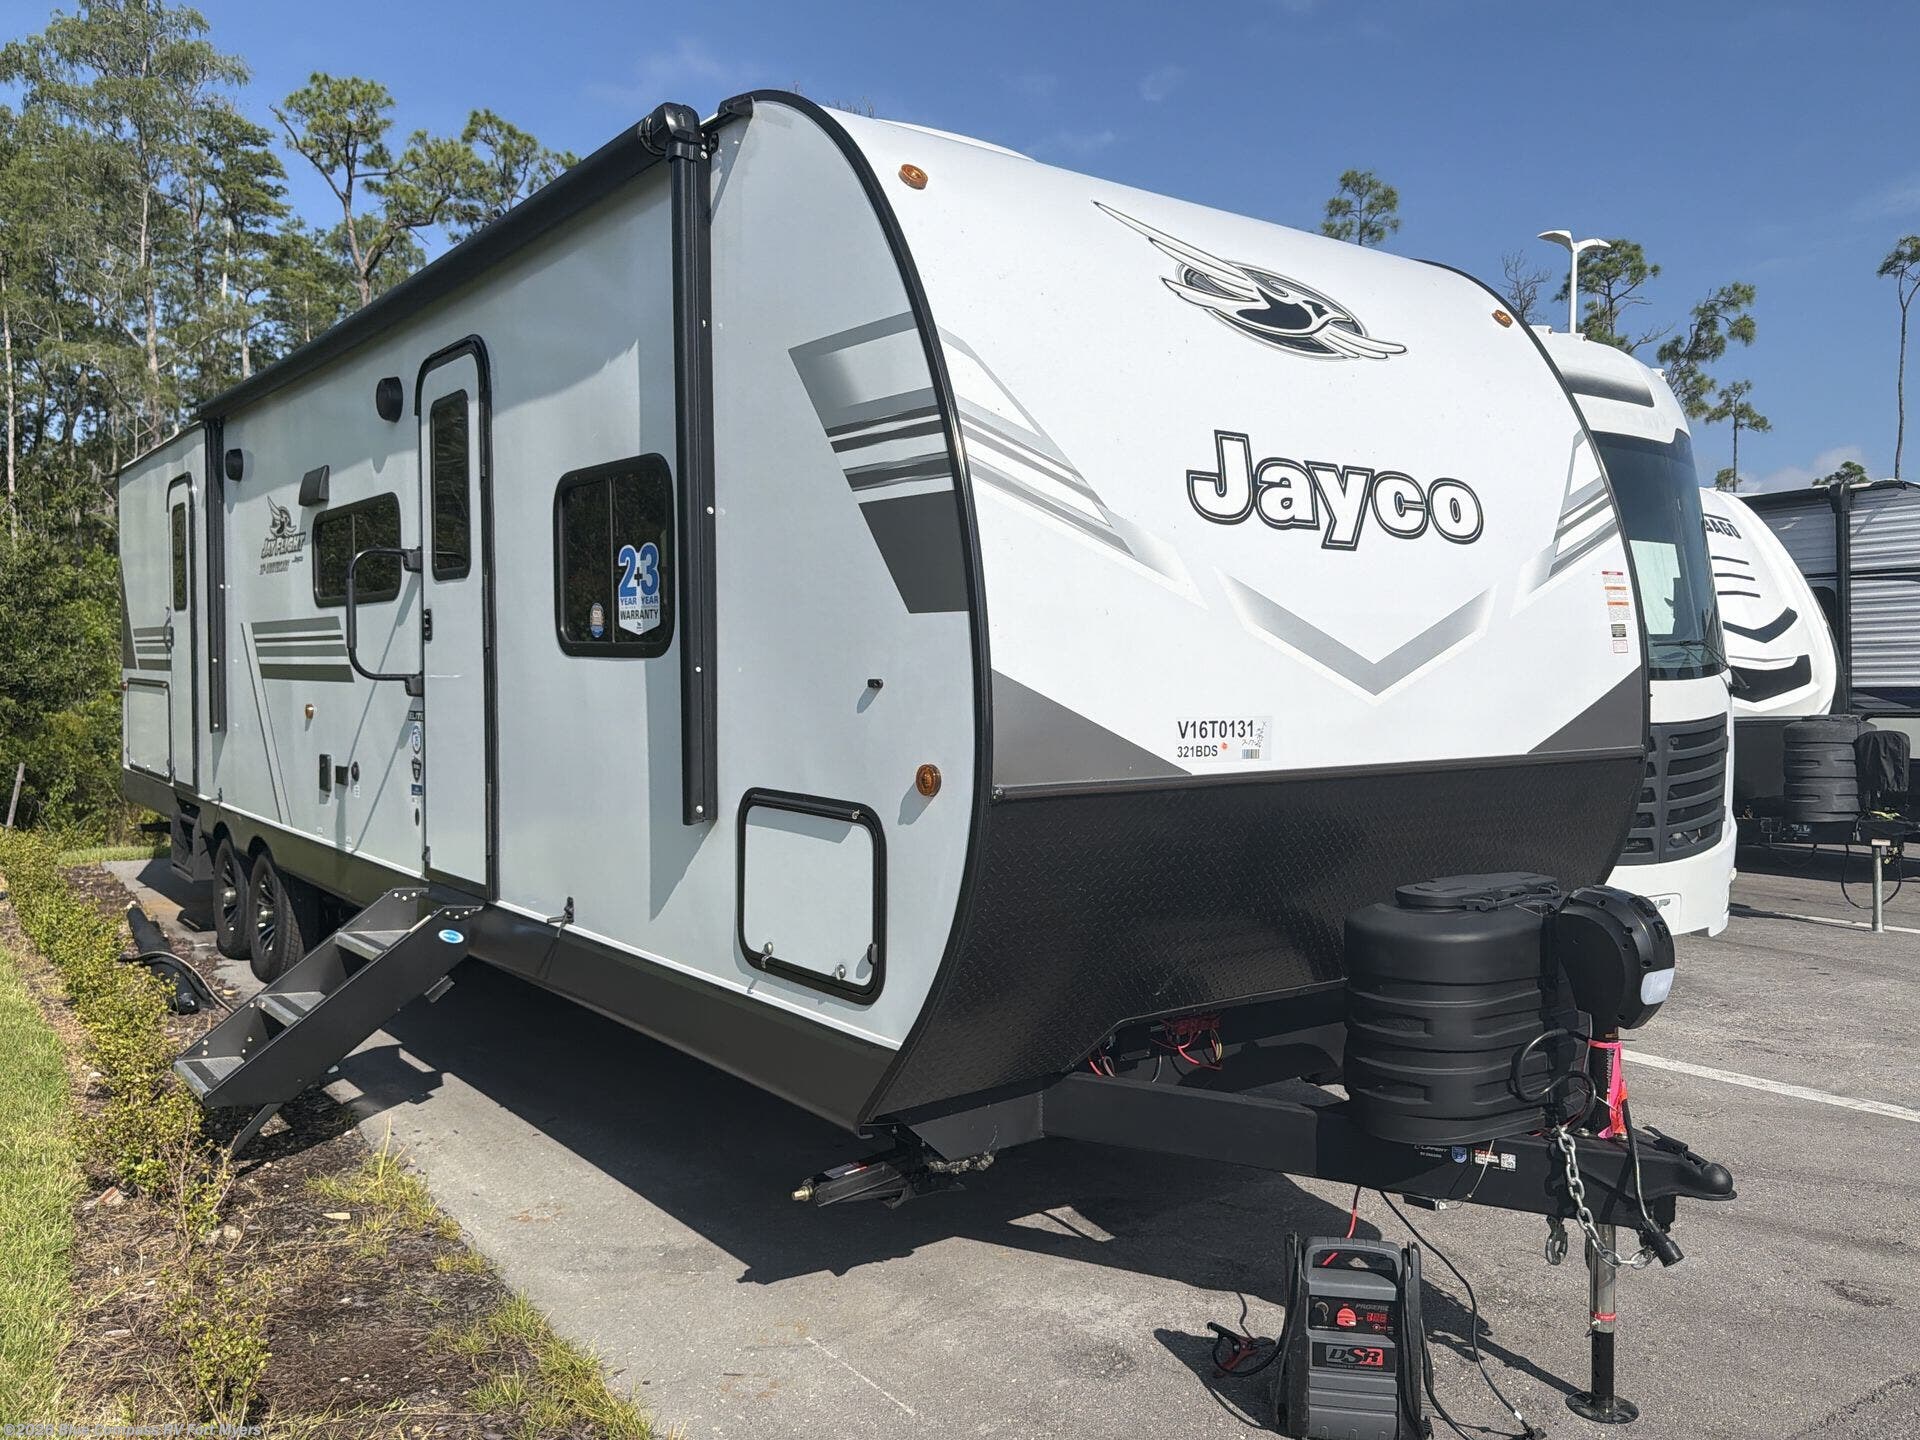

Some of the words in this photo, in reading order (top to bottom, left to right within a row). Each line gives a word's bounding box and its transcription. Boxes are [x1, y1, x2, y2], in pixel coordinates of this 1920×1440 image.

[1186, 429, 1484, 551] Jayco
[620, 598, 637, 606] YEAR
[641, 596, 659, 605] YEAR
[620, 609, 659, 620] WARRANTY
[1177, 720, 1253, 739] V16T0131
[1177, 745, 1218, 758] 321BDS
[1328, 1347, 1381, 1364] DSR
